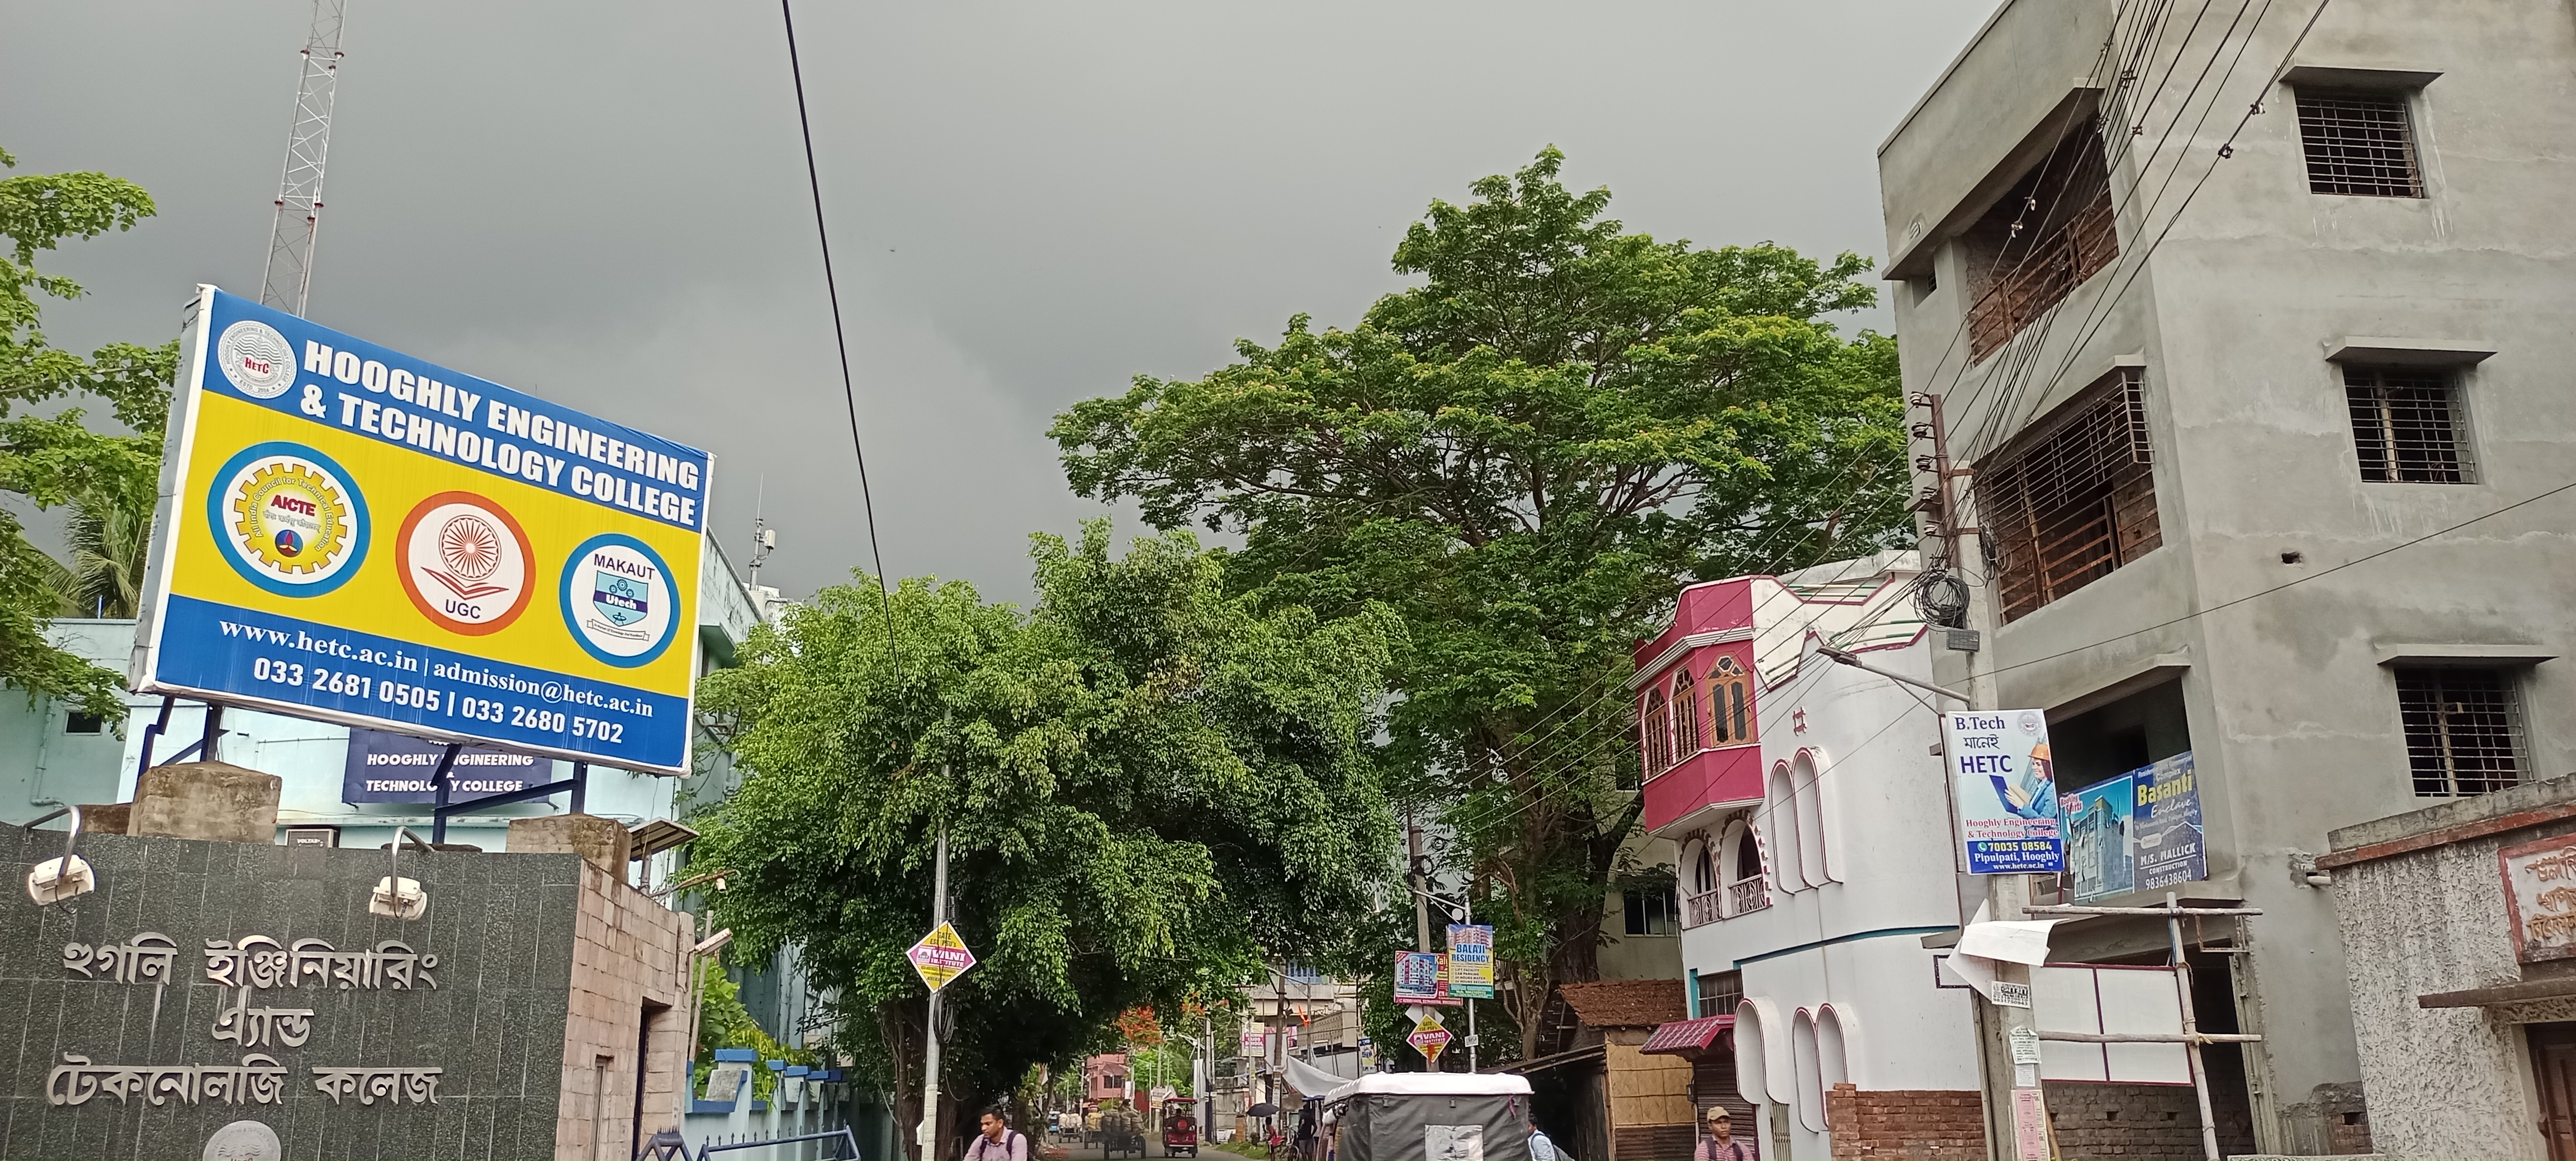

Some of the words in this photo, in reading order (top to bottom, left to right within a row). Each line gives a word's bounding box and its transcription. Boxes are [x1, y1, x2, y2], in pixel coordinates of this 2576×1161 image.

[245, 356, 269, 374] HETC
[304, 339, 481, 422] HOOGHLY
[487, 399, 699, 491] ENGINEERING
[300, 384, 327, 418] &
[339, 391, 563, 486] TECHNOLOGY
[571, 464, 695, 526] COLLEGE
[253, 476, 282, 501] Council
[283, 476, 295, 485] for
[297, 478, 331, 511] Technical
[249, 502, 258, 525] India
[271, 494, 316, 517] AICTE
[251, 525, 263, 537] All
[314, 512, 334, 551] Education
[594, 554, 655, 579] MAKAUT
[445, 598, 481, 619] UGC
[606, 594, 637, 610] Utech
[220, 619, 419, 673] www.hetc.ac.in
[434, 662, 653, 718] admission@hetc.ac.in
[253, 657, 304, 687] 033
[312, 668, 372, 699] 2681
[378, 680, 440, 712] 0505
[462, 696, 504, 724] 033
[510, 705, 565, 734] 2680
[572, 716, 623, 744] 5702
[1955, 716, 2006, 730] B.Tech
[1963, 734, 2001, 749] মানেই
[367, 754, 438, 766] HOOGHLY
[442, 754, 534, 766] GINEERING
[1960, 755, 2012, 774] HETC
[462, 780, 523, 792] COLLEGE
[2138, 769, 2192, 806] Basanti
[2151, 799, 2191, 818] Enclave
[1966, 819, 2001, 828] Hooghly
[2004, 818, 2056, 827] Engineering
[1976, 830, 2025, 839] Technology
[2028, 828, 2058, 838] College
[1988, 842, 2019, 852] 70035
[2021, 842, 2052, 851] 08584
[2140, 853, 2157, 866] M/S.
[2160, 843, 2196, 861] MALLICK
[1974, 852, 2020, 864] Pipulpati,
[2023, 851, 2059, 862] Hooghly
[2149, 860, 2187, 875] CONSTRUCTION
[2146, 869, 2192, 890] 9836438604
[1456, 944, 1485, 954] BALAJI
[63, 932, 179, 987] হুগলি
[47, 1053, 288, 1106] টেকনোলজি
[312, 1066, 443, 1106] কলেজ
